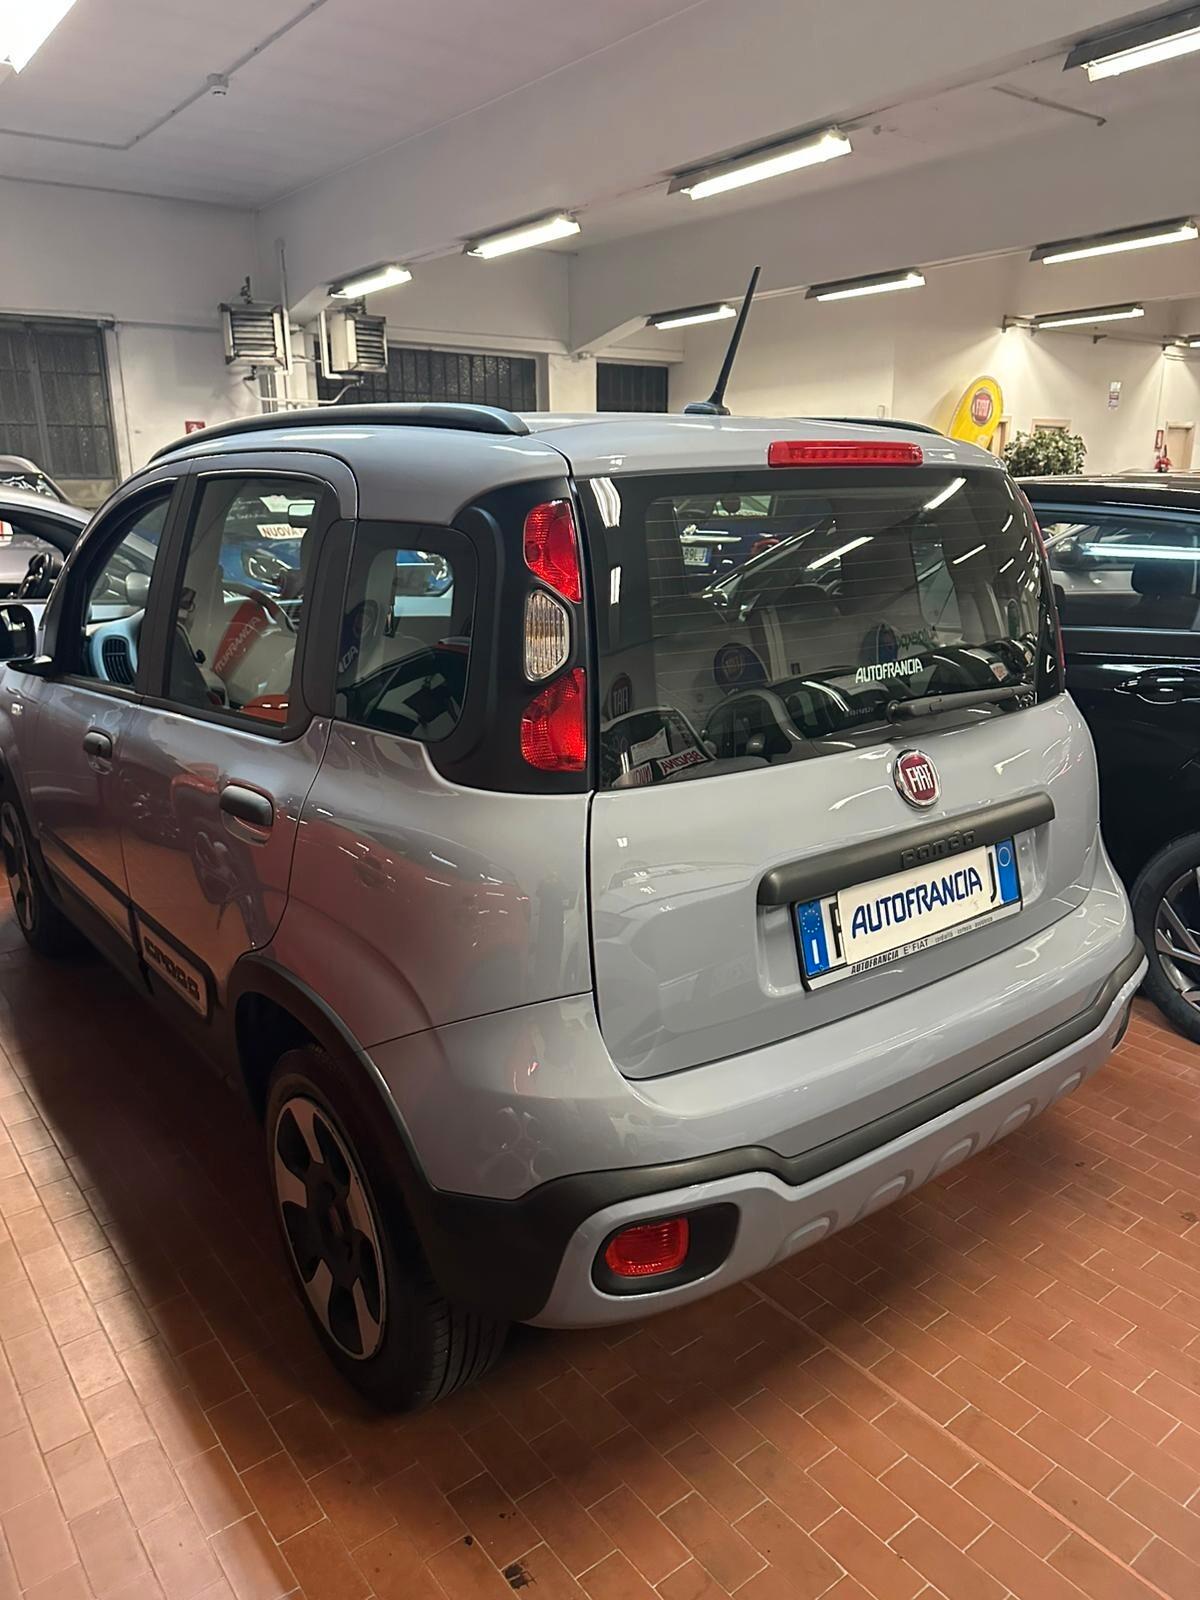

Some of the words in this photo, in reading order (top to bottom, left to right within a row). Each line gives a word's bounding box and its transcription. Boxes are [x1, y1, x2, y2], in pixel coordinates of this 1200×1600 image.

[855, 658, 923, 683] AUTOFRANCIA
[906, 764, 932, 792] FIAT
[851, 867, 983, 939] AUTOFRANCIA
[850, 949, 899, 975] AUTOFRANCIA
